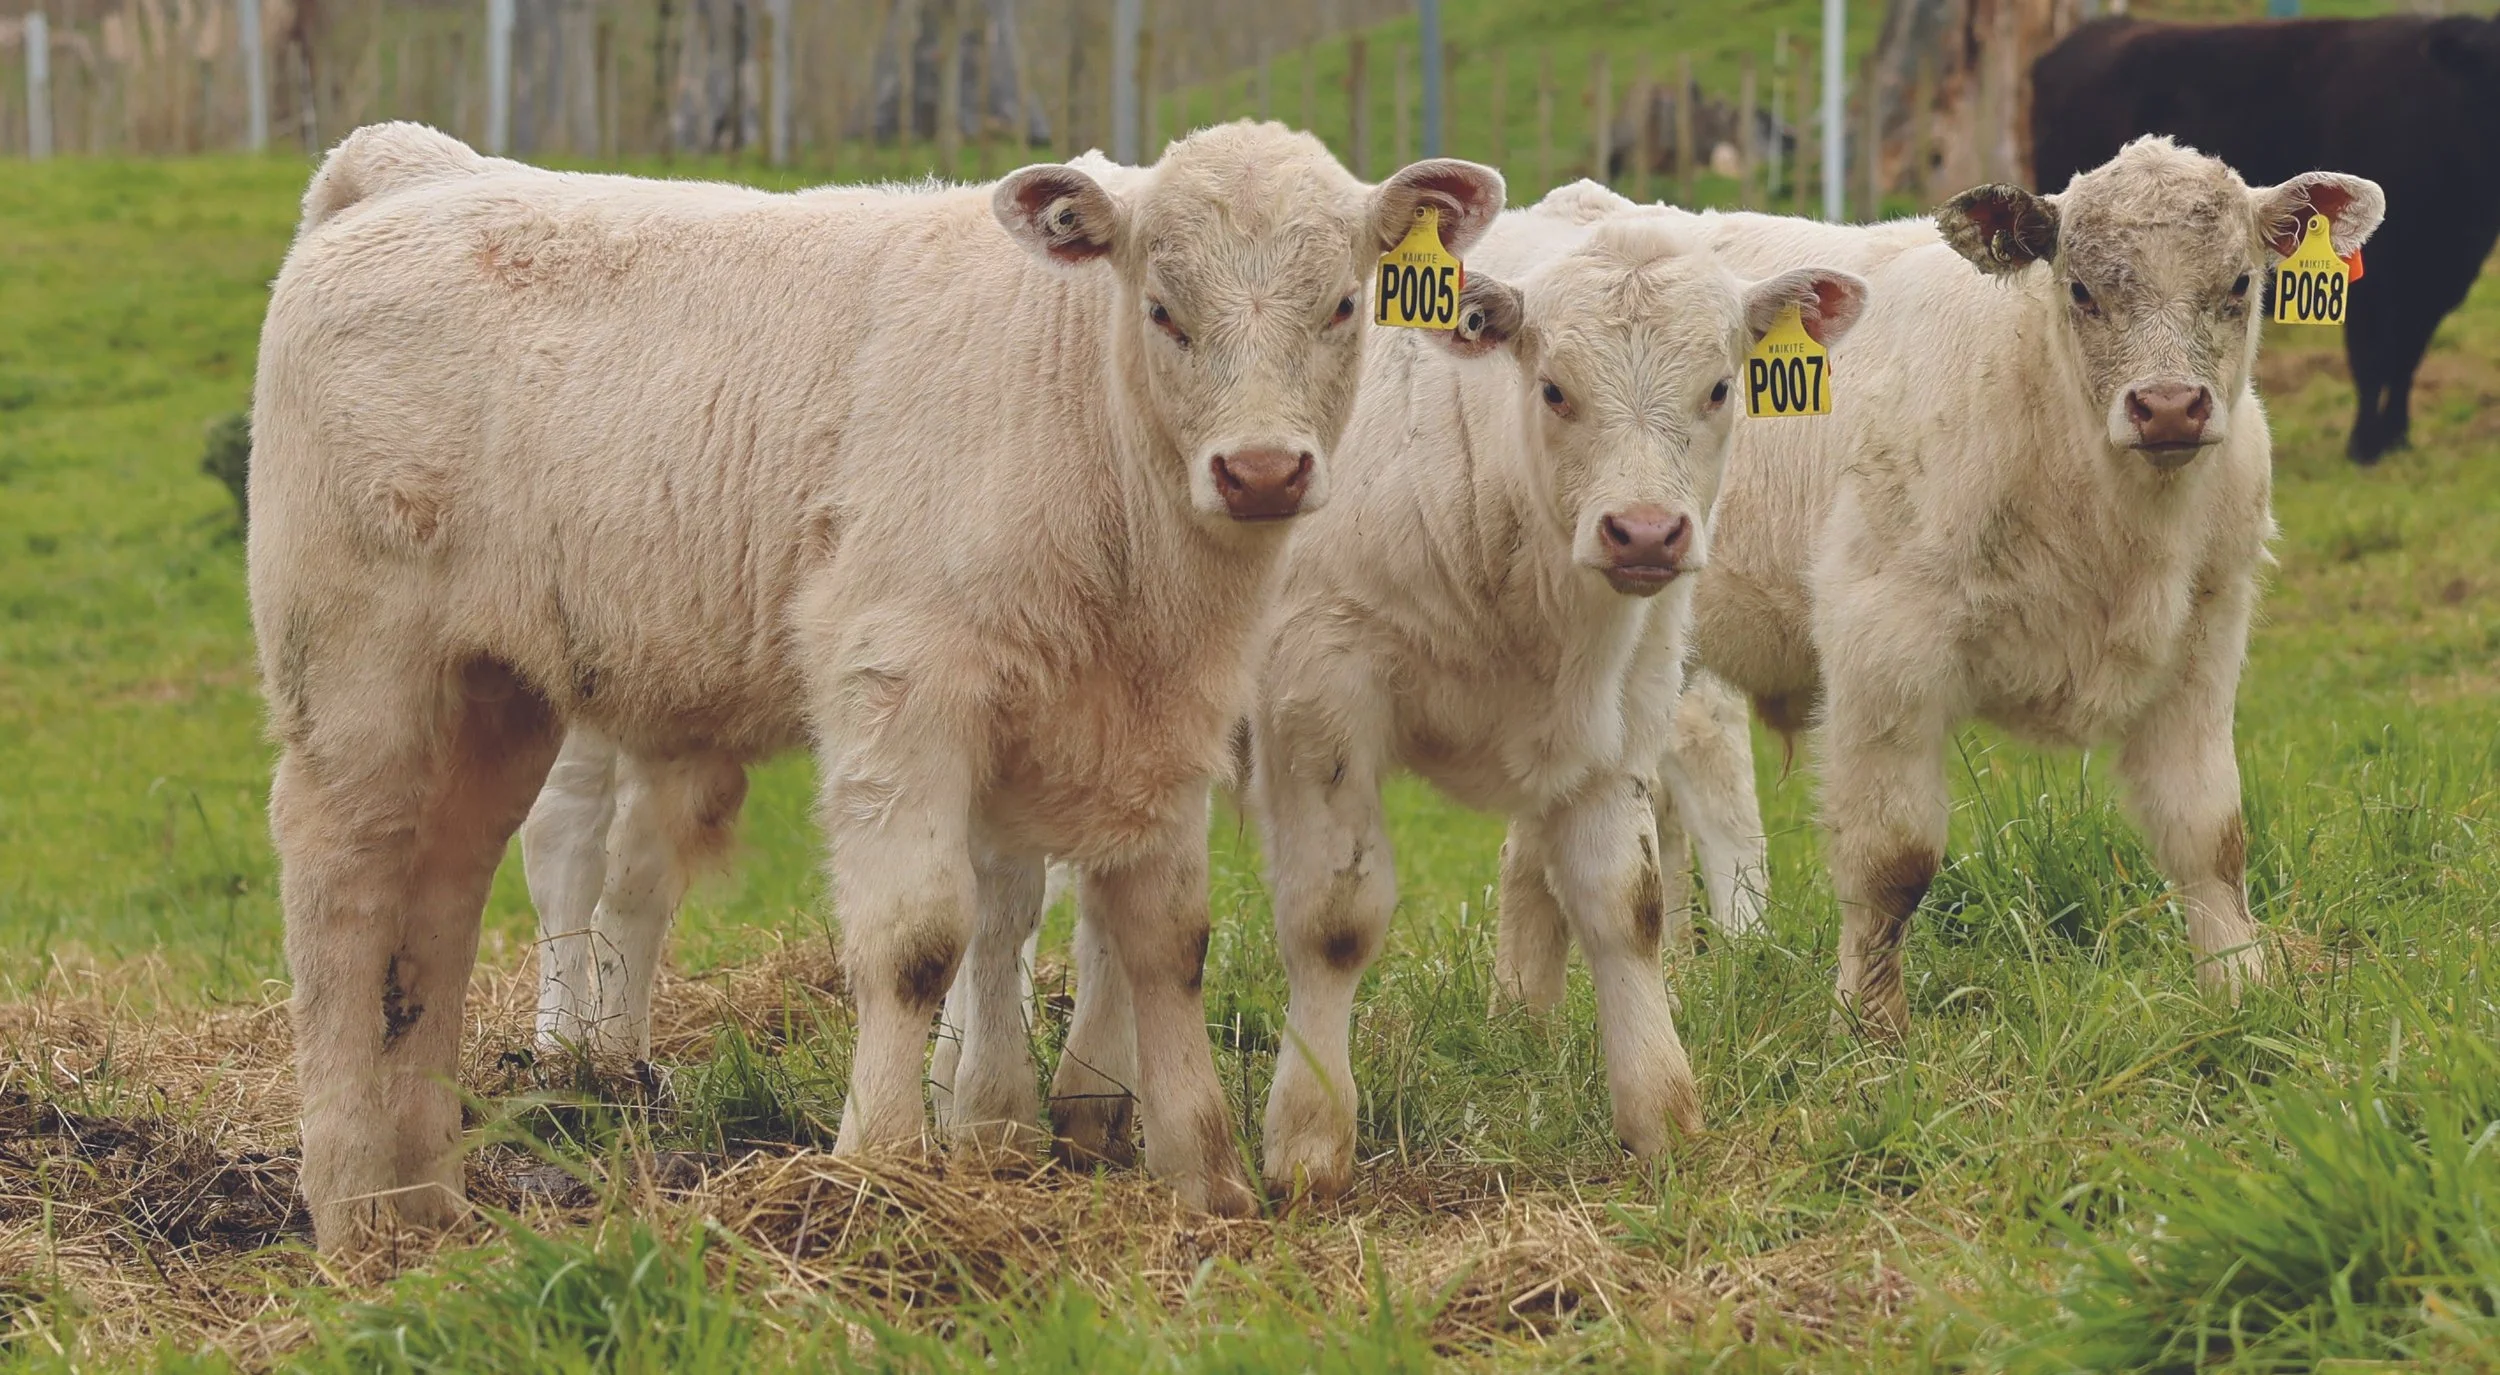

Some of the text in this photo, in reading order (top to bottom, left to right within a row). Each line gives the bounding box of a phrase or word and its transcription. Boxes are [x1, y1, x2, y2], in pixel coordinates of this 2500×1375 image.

[1402, 252, 1438, 264] WAIKITE
[2299, 259, 2330, 269] WAIKITE
[1380, 263, 1454, 324] P005
[2279, 270, 2344, 321] P068
[1768, 343, 1805, 354] WAIKITE
[1750, 356, 1823, 414] P007
